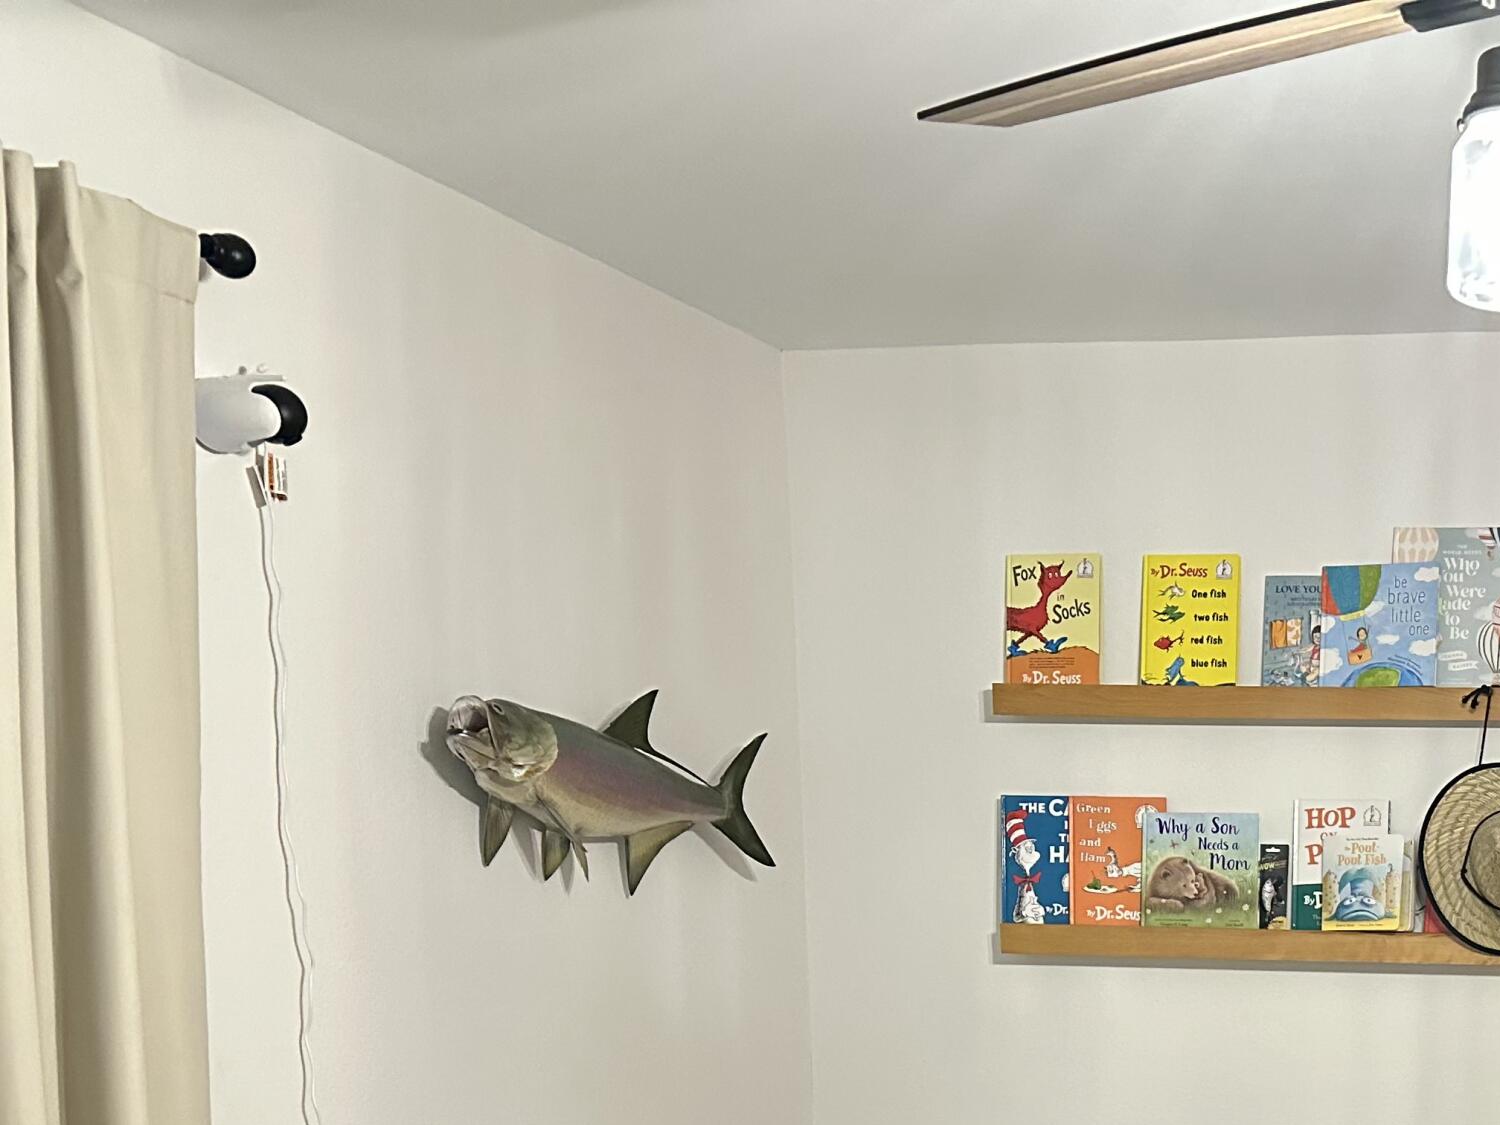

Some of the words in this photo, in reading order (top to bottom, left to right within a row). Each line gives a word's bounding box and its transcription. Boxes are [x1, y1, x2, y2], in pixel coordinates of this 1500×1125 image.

[1150, 568, 1160, 577] By
[1160, 564, 1178, 579] Dr.
[1178, 562, 1208, 578] Seuss
[1444, 557, 1480, 577] Who
[1012, 564, 1038, 587] Fox
[1442, 570, 1464, 583] ou
[1275, 584, 1301, 594] LOVE
[1394, 576, 1408, 589] be
[1056, 593, 1065, 601] in
[1191, 589, 1208, 598] One
[1210, 588, 1227, 598] fish
[1387, 587, 1426, 605] brave
[1446, 584, 1486, 598] Were
[1051, 598, 1092, 624] Socks
[1194, 613, 1210, 622] two
[1212, 612, 1229, 622] fish
[1391, 606, 1421, 623] little
[1445, 613, 1460, 626] to
[1409, 624, 1430, 636] one
[1450, 626, 1470, 640] Be
[1190, 635, 1204, 645] red
[1206, 635, 1223, 645] fish
[1191, 658, 1209, 668] blue
[1211, 658, 1228, 668] fish
[1022, 673, 1032, 684] By
[1032, 670, 1050, 685] Dr.
[1051, 670, 1082, 685] Seuss
[1018, 802, 1046, 814] THE
[1076, 803, 1111, 814] Green
[1304, 806, 1356, 829] HOP
[1155, 815, 1191, 842] Why
[1195, 822, 1206, 834] a
[1211, 816, 1240, 835] Son
[1079, 837, 1101, 847] and
[1198, 836, 1229, 851] Needs
[1231, 842, 1239, 851] a
[1080, 852, 1106, 863] Ham
[1209, 852, 1251, 871] Mom
[1337, 853, 1362, 866] Pout
[1363, 853, 1387, 865] Fish
[1303, 895, 1315, 906] By
[1053, 903, 1069, 916] Dr.
[1095, 905, 1114, 921] Dr.
